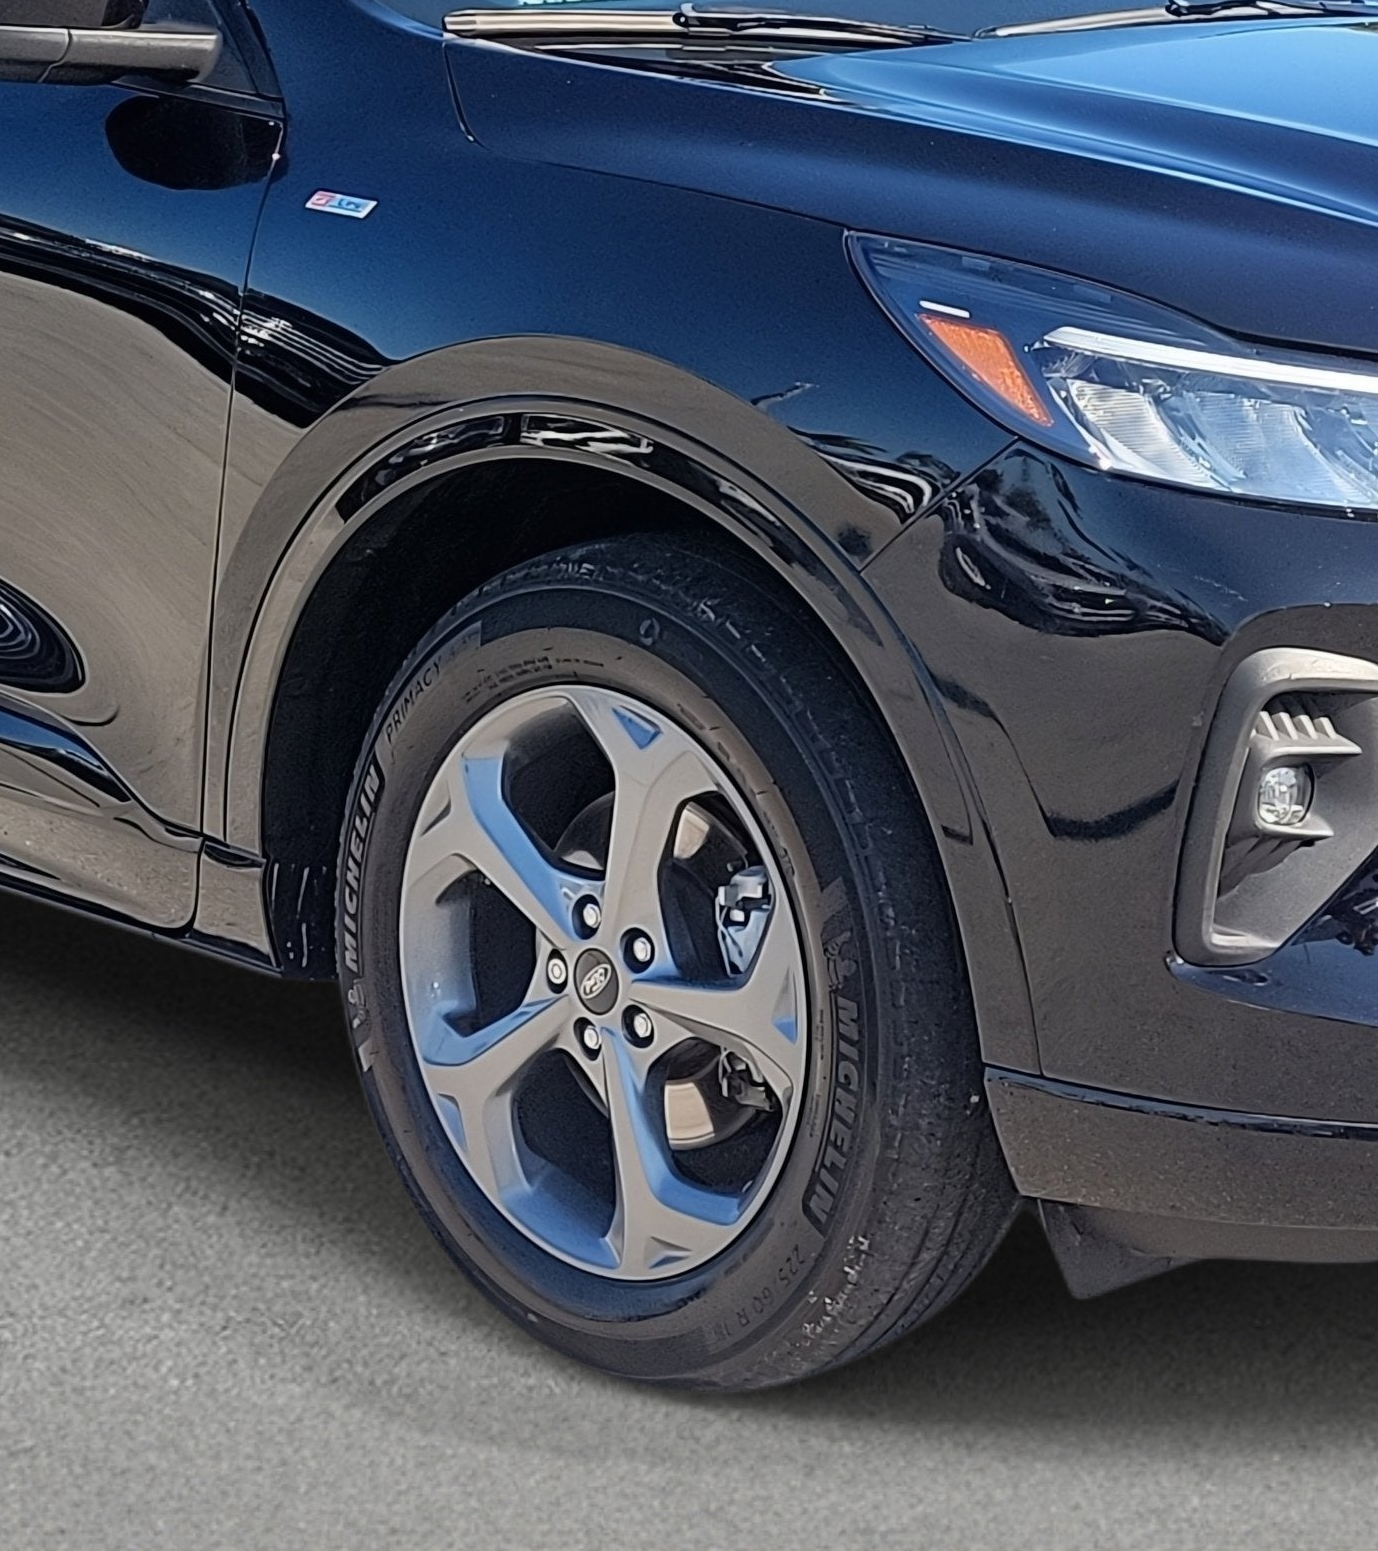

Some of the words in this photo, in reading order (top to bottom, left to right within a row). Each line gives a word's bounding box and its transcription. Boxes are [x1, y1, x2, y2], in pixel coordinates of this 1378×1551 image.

[384, 658, 443, 745] PRIMACY
[343, 761, 381, 974] MICHELIN
[809, 996, 859, 1225] MICHELIN
